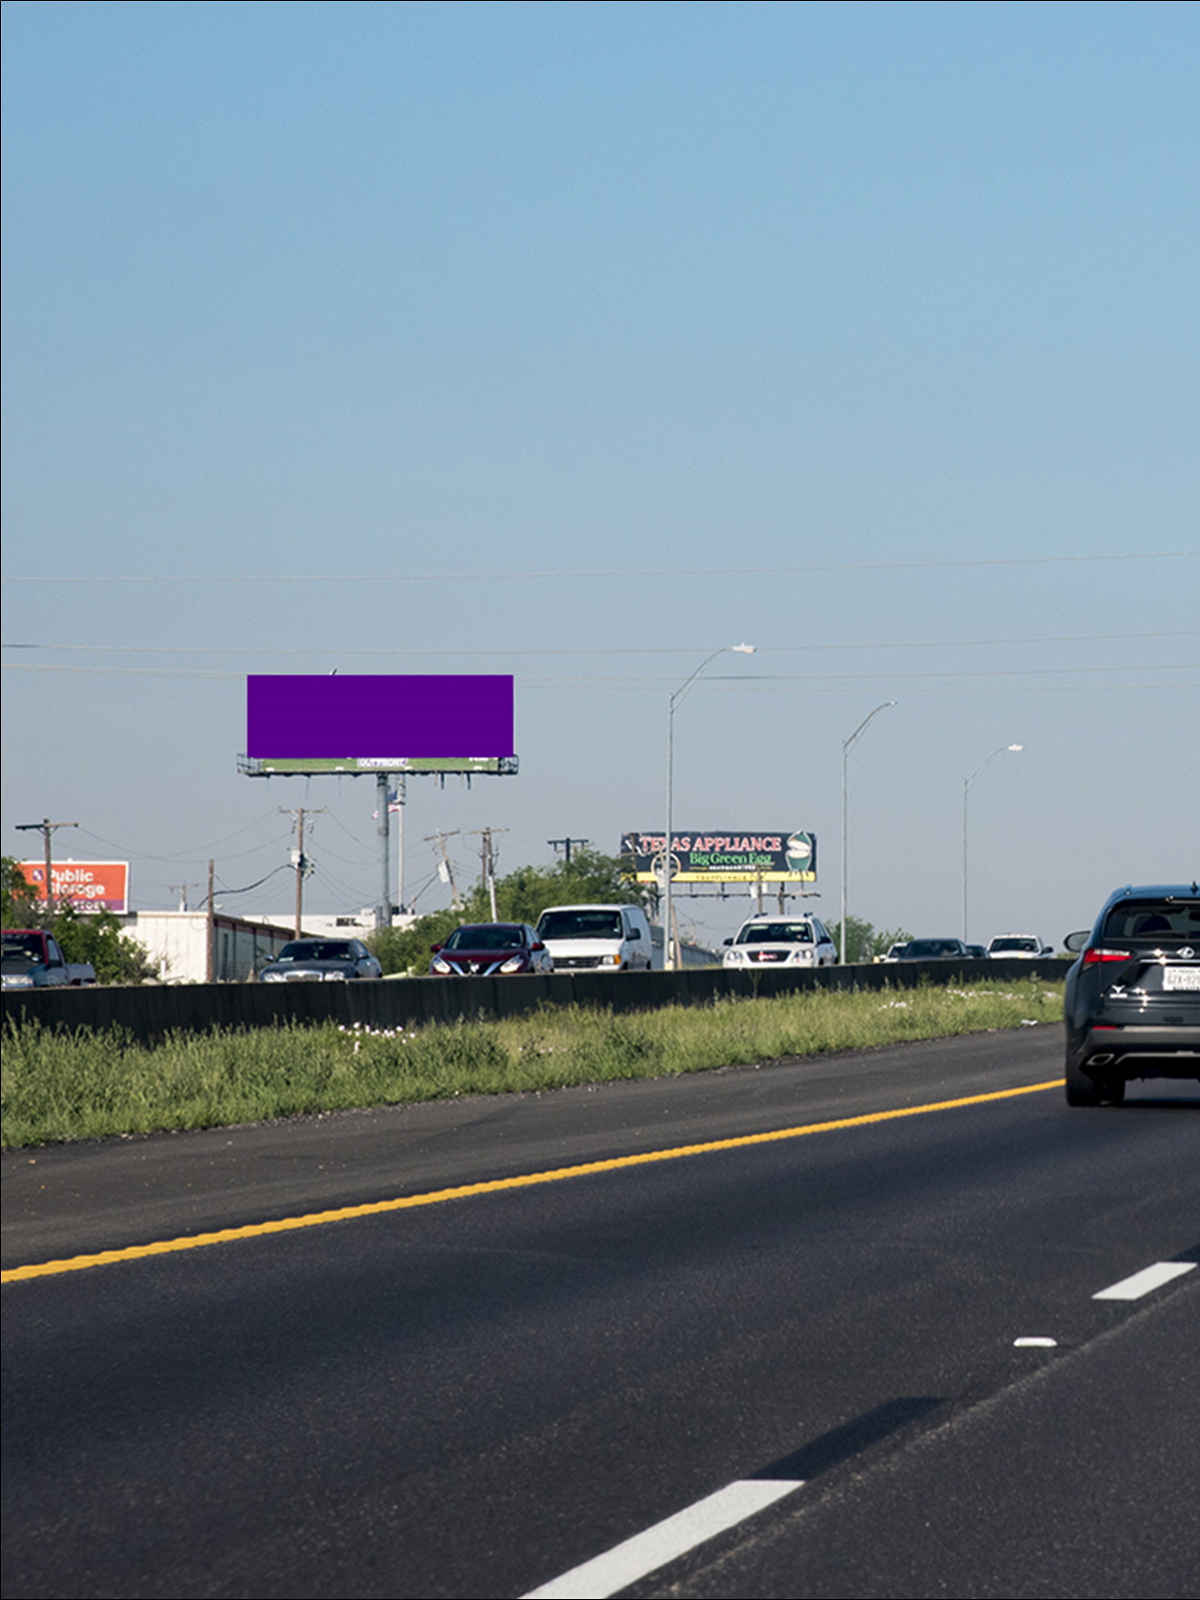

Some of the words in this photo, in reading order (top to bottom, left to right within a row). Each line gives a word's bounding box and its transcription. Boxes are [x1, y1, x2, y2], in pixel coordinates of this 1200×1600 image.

[693, 836, 782, 851] APPLIANCE
[689, 852, 710, 866] Big
[710, 852, 747, 864] Green
[749, 853, 772, 866] Egg
